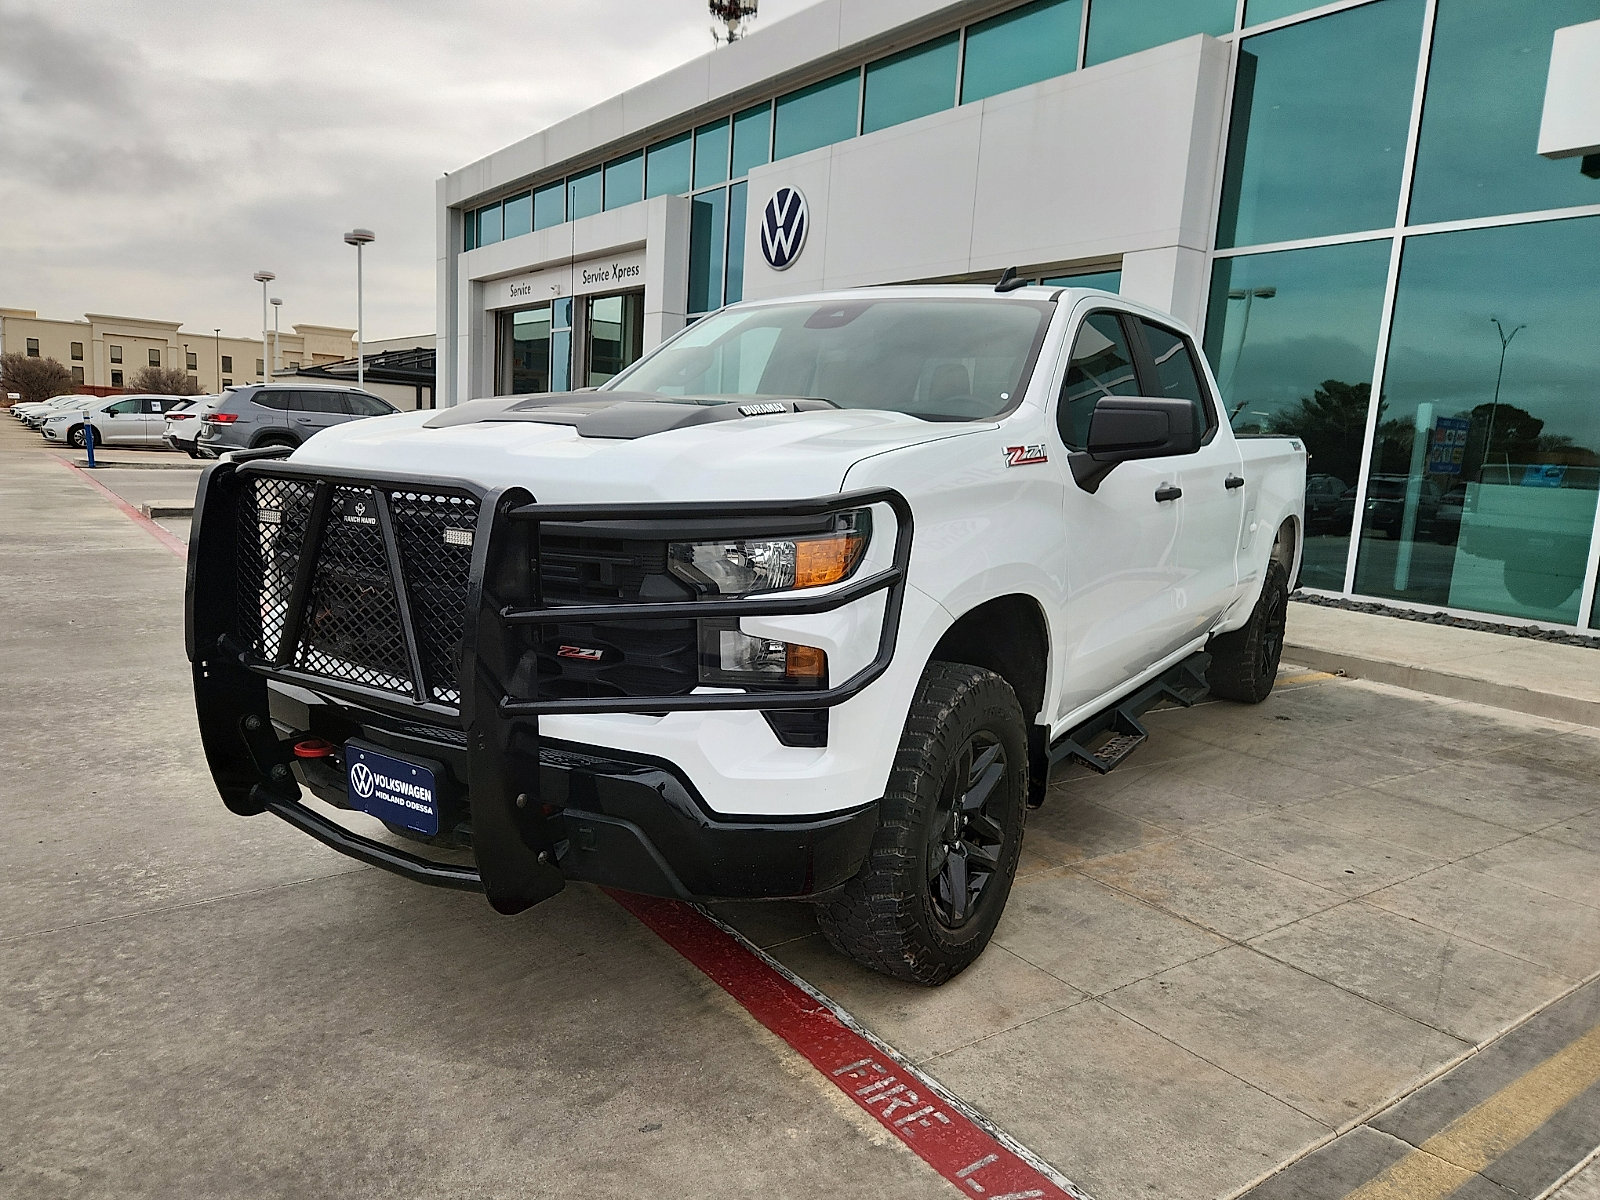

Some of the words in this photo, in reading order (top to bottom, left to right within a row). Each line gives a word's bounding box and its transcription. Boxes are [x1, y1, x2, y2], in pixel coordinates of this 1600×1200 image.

[760, 184, 809, 271] VW
[582, 267, 609, 285] Service
[612, 263, 640, 282] Xpress
[510, 283, 531, 297] Service
[738, 402, 787, 417] DURAMAX
[1001, 443, 1048, 468] Z71
[557, 645, 604, 660] Z71
[351, 763, 374, 798] VW
[374, 773, 432, 802] VOLKSWAGEN
[375, 790, 405, 806] MIDLAND
[405, 800, 434, 815] ODESSA
[832, 1057, 951, 1138] FIRE
